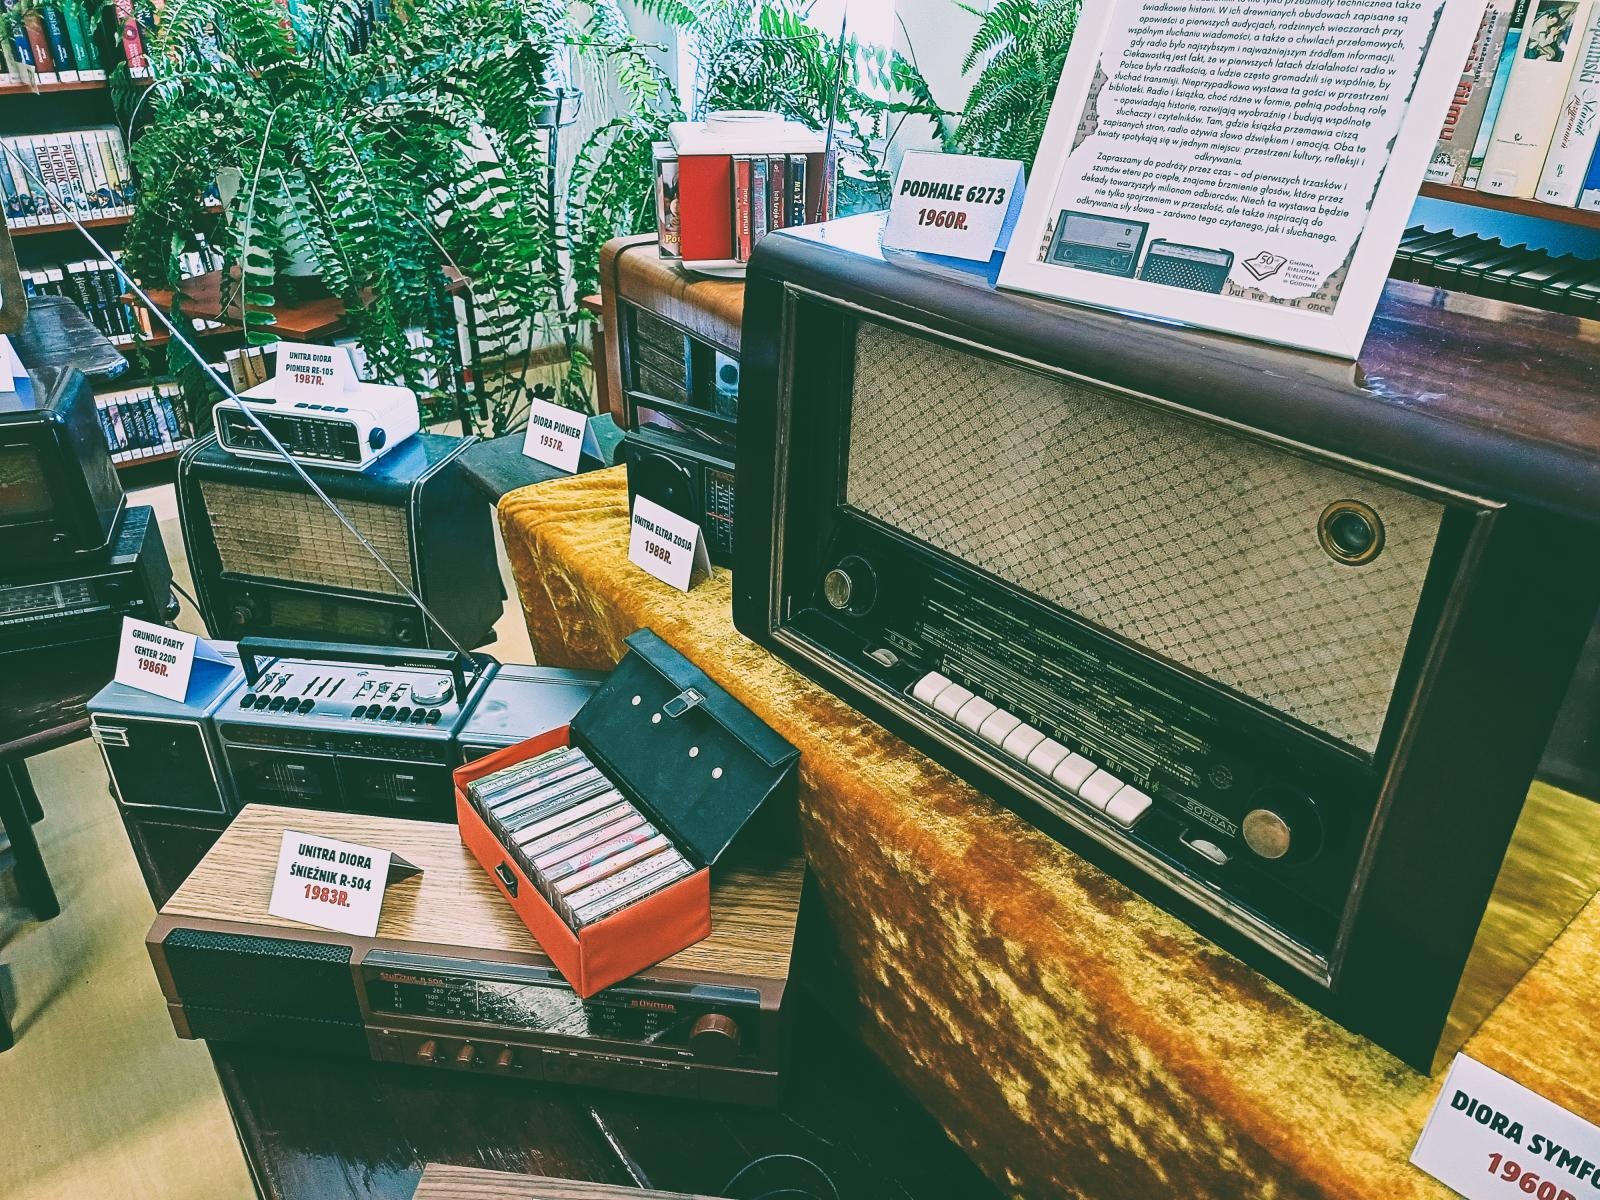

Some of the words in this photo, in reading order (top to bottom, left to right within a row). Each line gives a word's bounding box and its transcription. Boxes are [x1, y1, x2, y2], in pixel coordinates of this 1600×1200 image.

[1139, 16, 1178, 24] opowieści
[1185, 18, 1230, 28] pierwszych
[1231, 18, 1276, 31] audycjach,
[1278, 21, 1326, 33] rodzinnych
[1327, 25, 1380, 34] wieczorach
[1381, 28, 1404, 38] przy
[1142, 3, 1187, 13] świadkowie
[1188, 4, 1216, 14] historii.
[1228, 6, 1241, 15] ich
[1242, 6, 1297, 20] drewnianych
[1298, 9, 1351, 20] obudowach
[1353, 13, 1395, 23] zapisane
[1397, 15, 1408, 25] są
[1130, 37, 1146, 48] gdy
[1146, 38, 1168, 48] radio
[1169, 39, 1186, 51] było
[1187, 42, 1235, 54] najszybszym
[1242, 46, 1307, 59] najważniejszym
[1309, 49, 1345, 59] źródłem
[1347, 51, 1395, 64] informacji.
[1114, 71, 1142, 82] słuchać
[1143, 75, 1179, 87] transmisji.
[1181, 77, 1250, 91] Nieprzypadkowo
[1252, 85, 1289, 94] wystawa
[1290, 86, 1300, 95] ta
[1301, 88, 1327, 98] gości
[1336, 92, 1389, 101] przestrzeni
[1116, 106, 1152, 120] słuchaczy
[1157, 112, 1204, 124] czytelników.
[1206, 116, 1224, 127] Tam,
[1225, 118, 1249, 129] gdzie
[1251, 120, 1282, 132] książka
[1283, 126, 1333, 137] przemawia
[1335, 130, 1359, 142] ciszą
[48, 145, 68, 183] PILIPIUK
[62, 144, 80, 179] PILIPIUK
[1194, 152, 1242, 165] odkrywania.
[900, 179, 964, 201] PODHALE
[966, 186, 1006, 205] 6273
[1081, 172, 1109, 186] dekady
[1110, 178, 1156, 192] towarzyszyły
[1157, 184, 1192, 195] milionom
[1193, 188, 1238, 202] odbiorców.
[1240, 195, 1265, 205] Niech
[1267, 199, 1277, 207] ta
[1278, 202, 1316, 213] wystawa
[1318, 204, 1349, 217] będzie
[1092, 165, 1121, 174] szumów
[1122, 168, 1142, 176] eteru
[1142, 171, 1154, 180] po
[1155, 172, 1181, 183] ciepłe,
[1182, 177, 1216, 187] znajome
[1217, 178, 1258, 192] brzmienie
[1259, 184, 1291, 198] głosów,
[1293, 188, 1316, 200] które
[1317, 195, 1344, 204] przez
[918, 208, 968, 231] 1960R.
[1076, 196, 1119, 209] odkrywania
[1120, 202, 1132, 213] siły
[1132, 203, 1155, 214] słowa
[1163, 210, 1197, 221] zarówno
[1198, 214, 1217, 226] tego
[1219, 219, 1264, 232] czytanego,
[1264, 224, 1280, 234] jak
[1286, 227, 1337, 241] słuchanego.
[1094, 188, 1106, 196] nie
[1108, 188, 1125, 199] tylko
[1126, 193, 1172, 205] spojrzeniem
[1180, 201, 1224, 213] przeszłość,
[1226, 205, 1240, 215] ale
[1242, 208, 1265, 218] także
[1266, 212, 1309, 227] inspiracją
[1311, 217, 1323, 227] do
[1259, 255, 1274, 265] 50
[1229, 287, 1245, 298] but
[1307, 305, 1331, 313] once
[285, 363, 311, 374] PIONIER
[311, 366, 334, 376] RE-105
[289, 351, 312, 361] UNITRA
[312, 354, 332, 363] DIORA
[293, 373, 325, 386] 1987R.
[533, 414, 553, 431] DIORA
[553, 420, 581, 440] PIONIER
[540, 434, 564, 452] 1957R.
[634, 514, 655, 533] UNITRA
[655, 523, 673, 543] ELTRA
[673, 533, 692, 551] ZOSIA
[644, 540, 672, 565] 1988R.
[132, 629, 162, 646] GRUNDIG
[162, 636, 184, 651] PARTY
[134, 645, 159, 660] CENTER
[158, 651, 176, 664] 2200
[138, 658, 169, 678] 1986R.
[1186, 800, 1238, 835] SOPRAN
[298, 843, 336, 862] UNITRA
[339, 851, 372, 869] DIORA
[289, 862, 337, 884] ŚNIEŻNIK
[340, 874, 372, 891] R-504
[304, 883, 350, 907] 1983R.
[1450, 1089, 1524, 1145] DIORA
